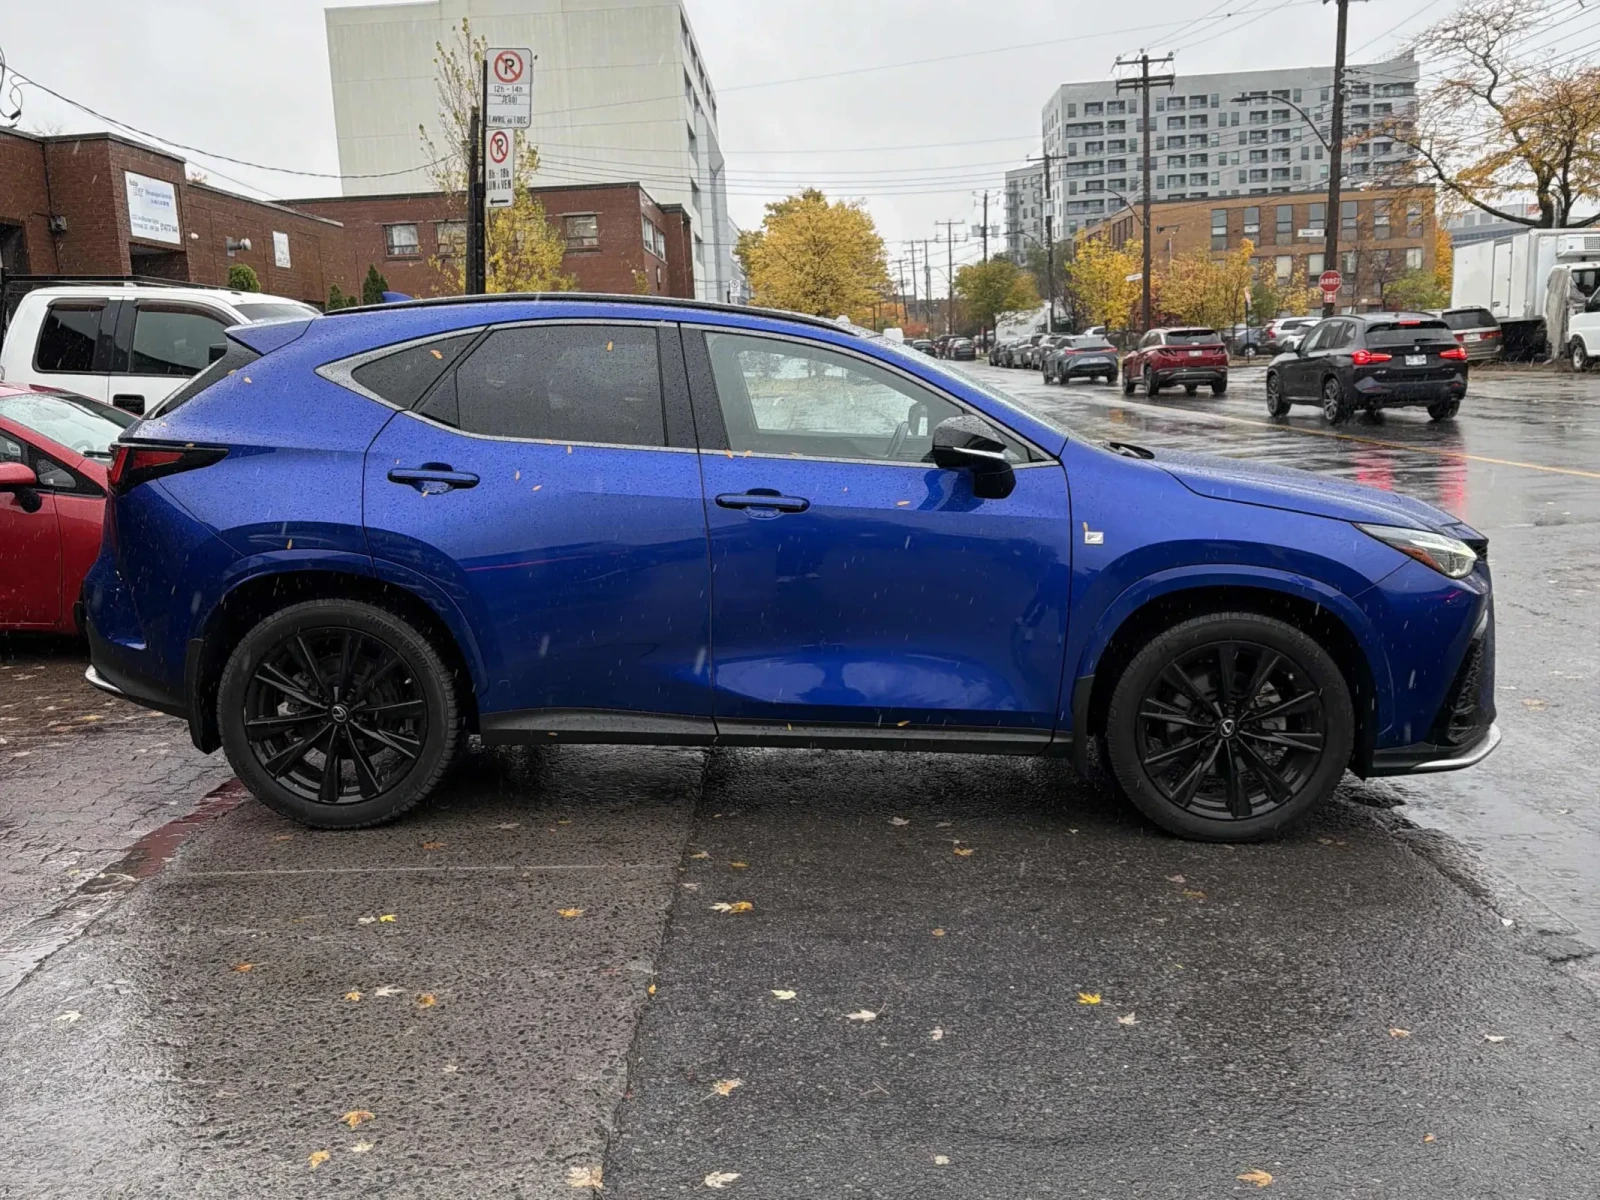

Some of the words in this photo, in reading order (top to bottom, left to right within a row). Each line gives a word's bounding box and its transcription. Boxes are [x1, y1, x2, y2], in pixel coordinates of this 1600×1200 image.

[494, 85, 505, 93] 12h
[512, 85, 523, 93] 14h
[501, 95, 518, 104] JEUDI
[492, 115, 506, 123] AVRIL
[486, 180, 496, 191] LUN
[501, 179, 511, 189] VEN
